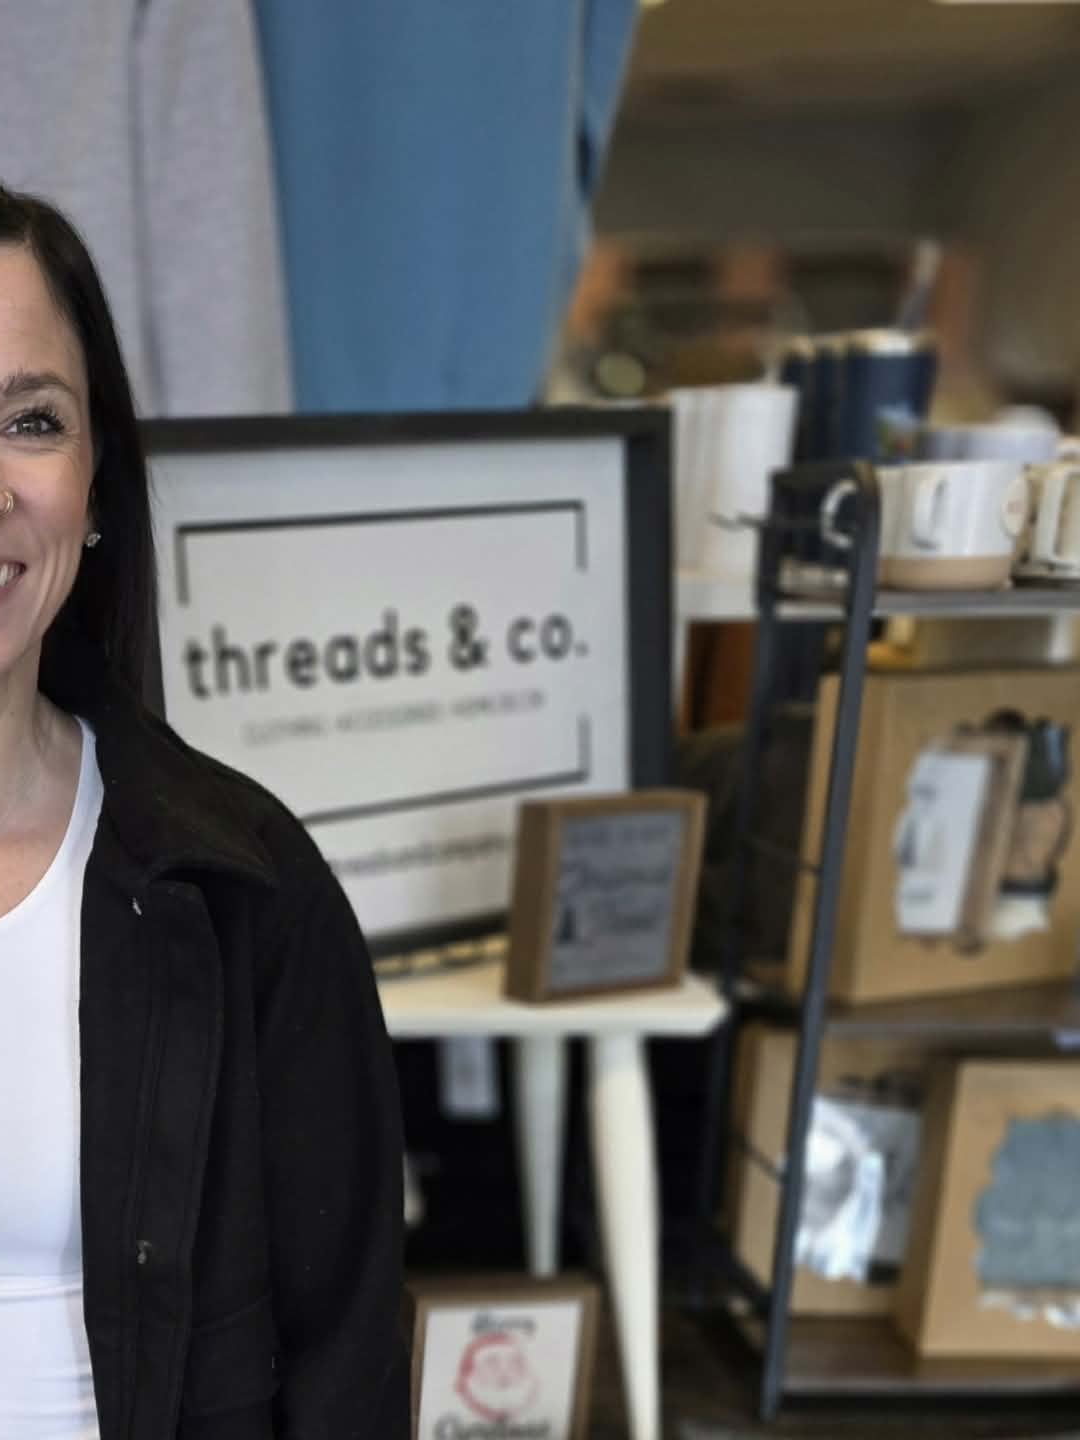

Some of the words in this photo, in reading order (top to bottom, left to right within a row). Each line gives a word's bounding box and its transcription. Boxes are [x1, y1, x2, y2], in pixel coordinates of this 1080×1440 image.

[184, 609, 430, 701] threads
[448, 603, 490, 671] &
[506, 612, 590, 664] co.
